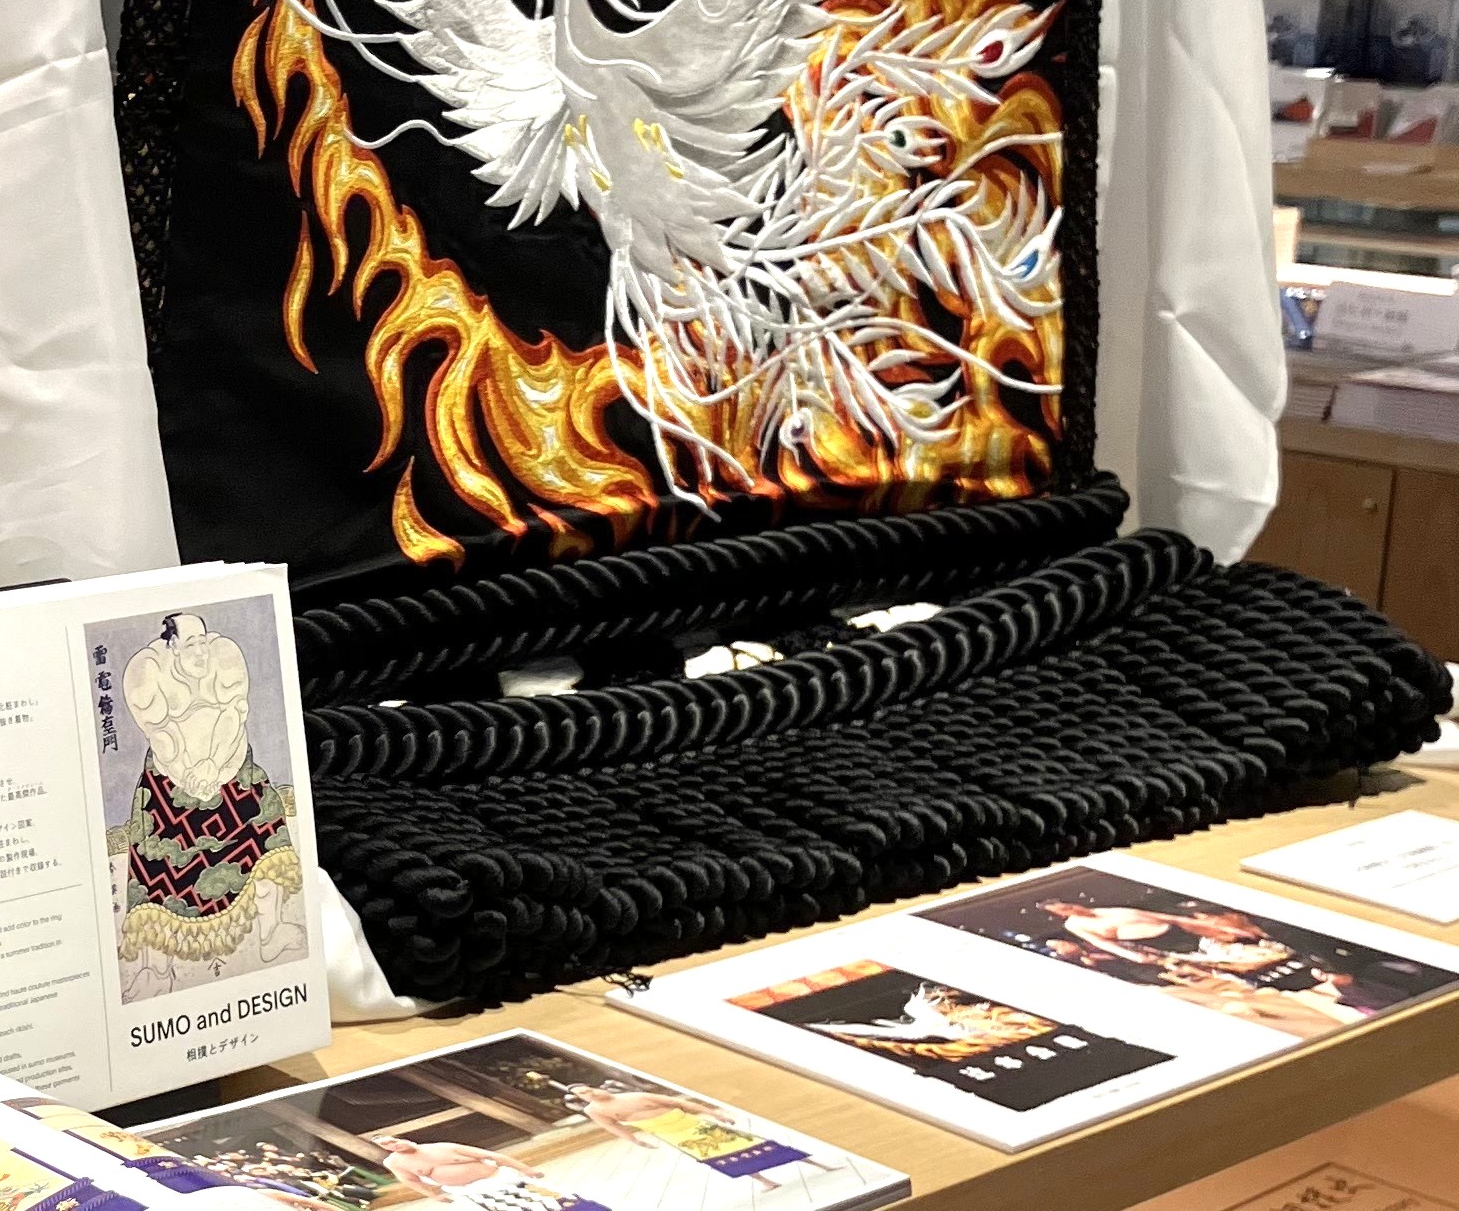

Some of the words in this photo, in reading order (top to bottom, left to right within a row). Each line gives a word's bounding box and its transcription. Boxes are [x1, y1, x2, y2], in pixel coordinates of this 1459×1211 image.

[130, 1014, 191, 1048] SUMO
[197, 1003, 232, 1031] and
[237, 983, 308, 1020] DESIGN
[186, 1033, 260, 1062] 相撲とデザイン
